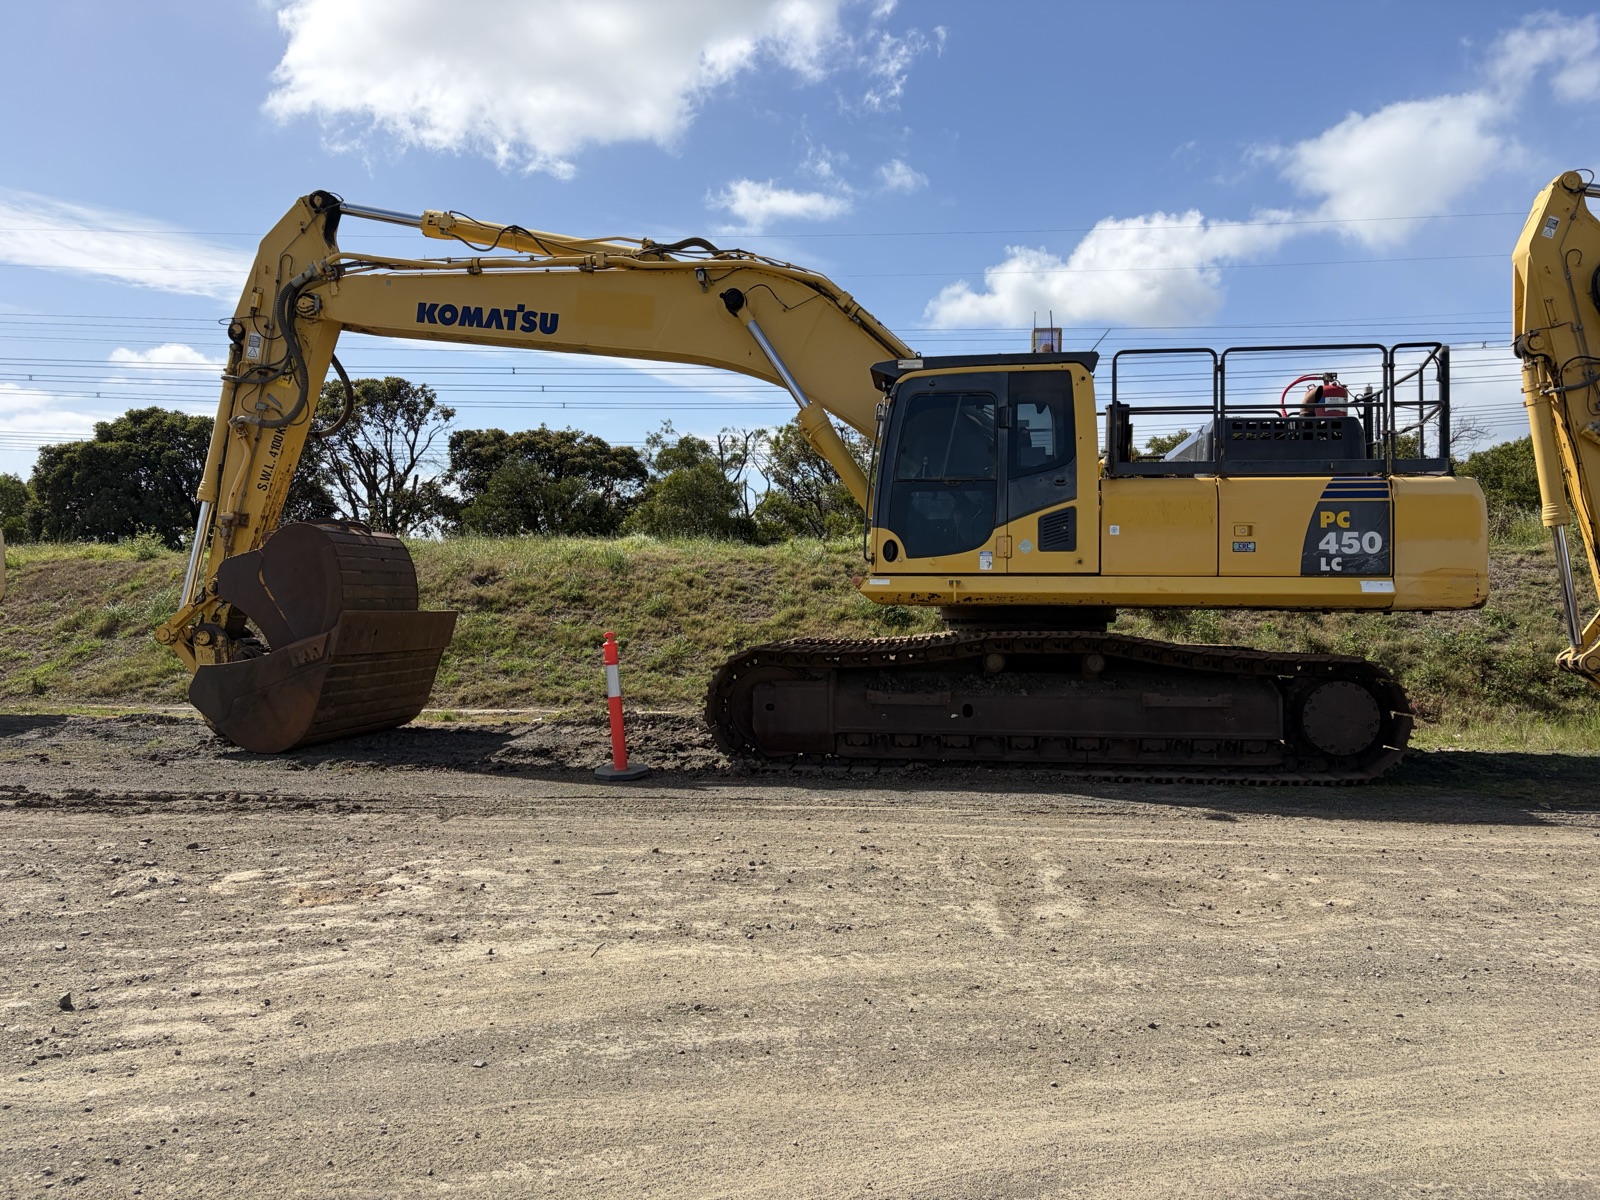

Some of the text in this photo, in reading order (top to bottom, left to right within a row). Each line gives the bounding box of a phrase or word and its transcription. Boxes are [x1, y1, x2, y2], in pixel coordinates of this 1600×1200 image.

[416, 302, 559, 335] KOMATSU
[269, 425, 288, 458] 4100K
[1320, 511, 1350, 528] PC
[1318, 531, 1383, 554] 450
[1320, 557, 1342, 571] LC
